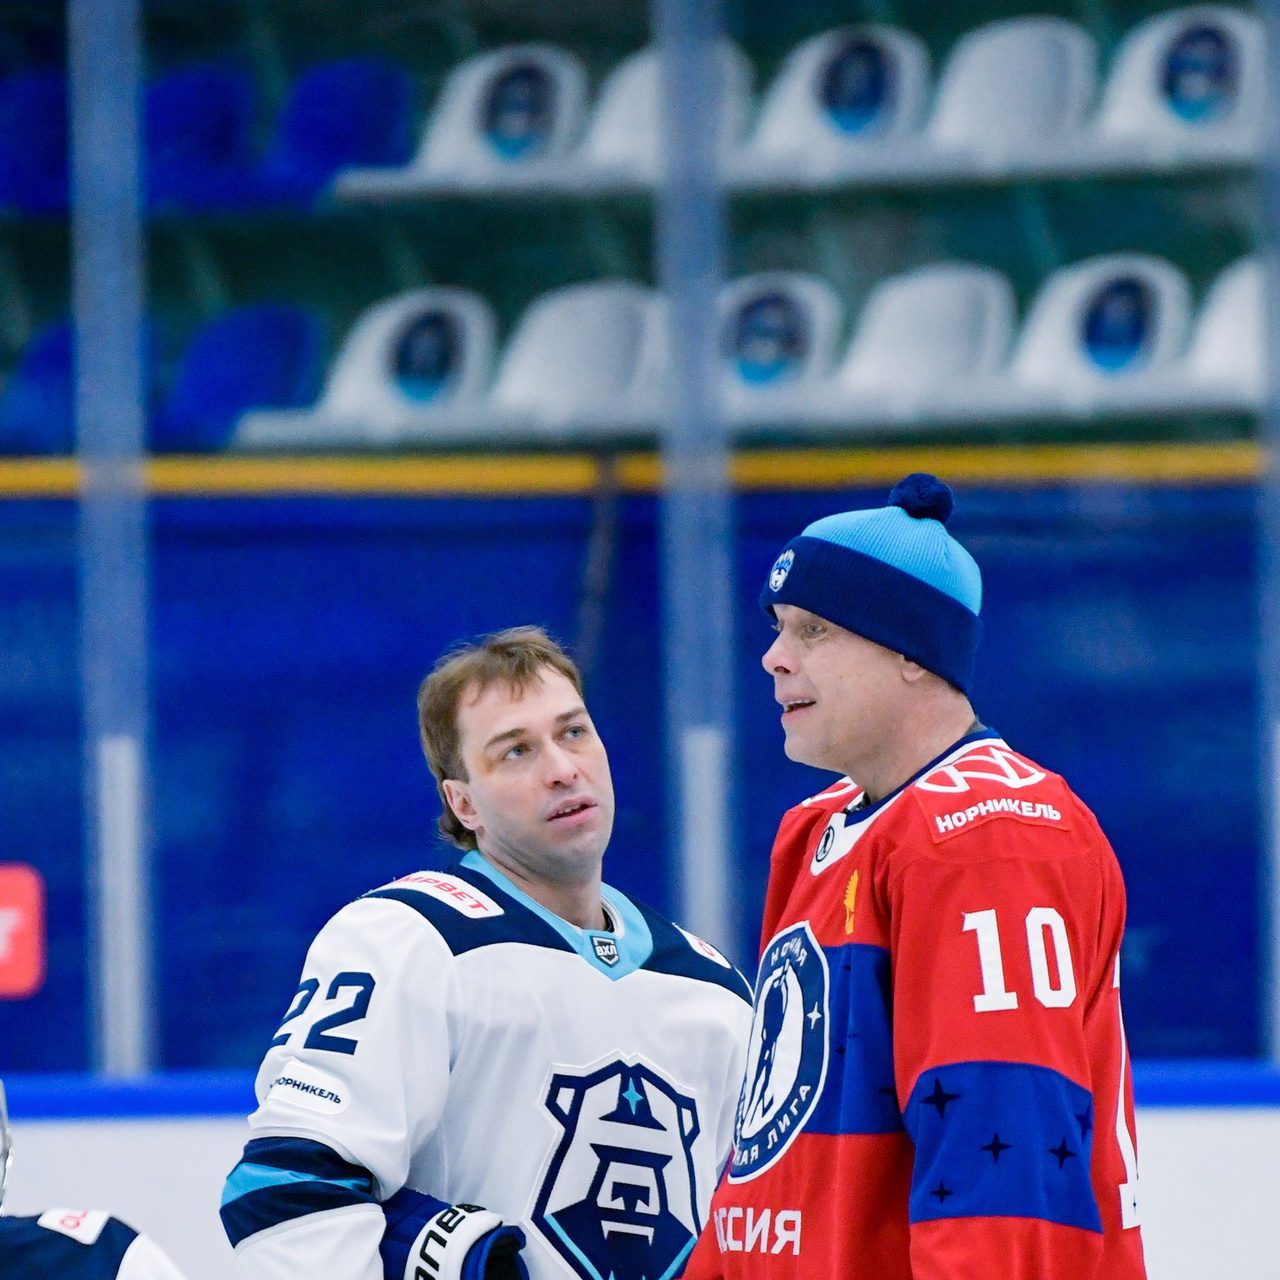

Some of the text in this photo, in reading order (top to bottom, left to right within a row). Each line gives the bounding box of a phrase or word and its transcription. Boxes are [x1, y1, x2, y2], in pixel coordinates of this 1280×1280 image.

[935, 798, 1062, 834] НОРНИКЕЛЬ
[595, 944, 618, 956] ВХЛ
[962, 906, 1077, 1012] 10
[272, 971, 376, 1056] 22
